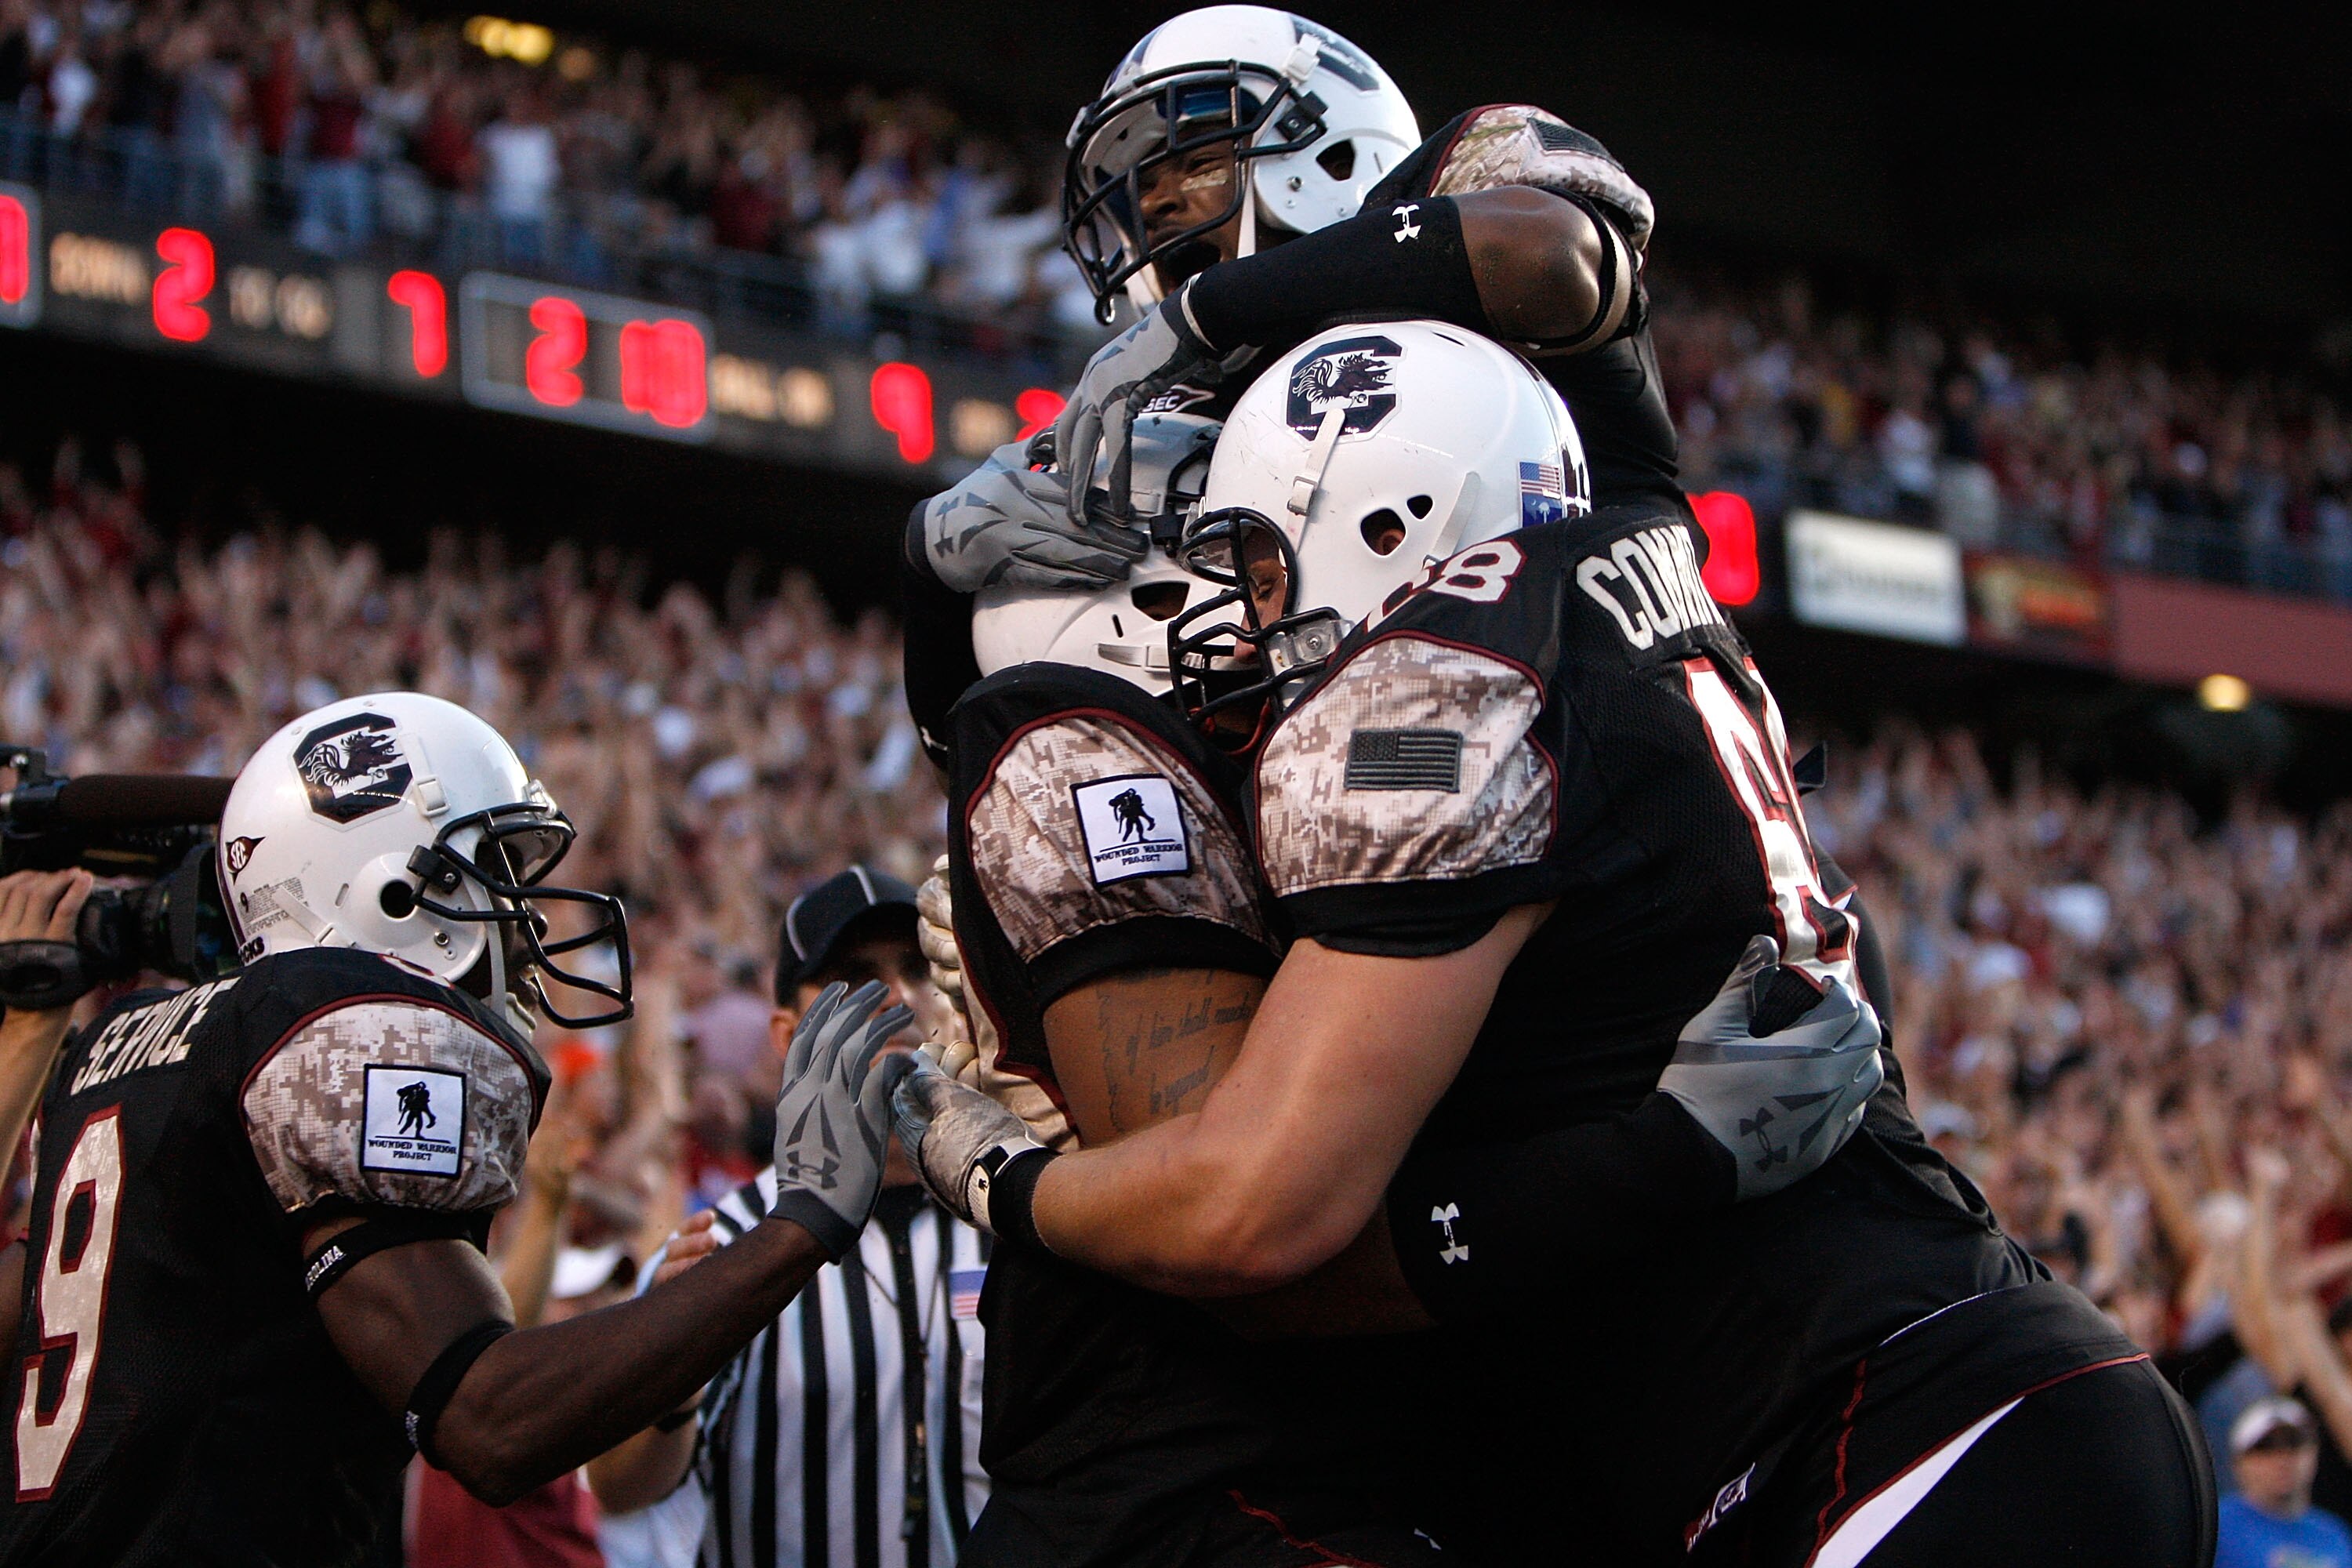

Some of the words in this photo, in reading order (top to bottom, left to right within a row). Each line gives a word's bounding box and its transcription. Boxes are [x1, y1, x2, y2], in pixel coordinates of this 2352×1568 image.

[153, 227, 215, 343] 2
[526, 297, 586, 407] 2
[1142, 395, 1180, 412] SEC
[1094, 847, 1139, 863] WOUNDED
[1143, 844, 1183, 854] WARRIOR
[1122, 854, 1161, 866] PROJECT
[71, 976, 241, 1096] SERVICE
[368, 1139, 412, 1150] WOUNDED
[417, 1142, 457, 1155] WARRIOR
[393, 1150, 433, 1161] PROJECT
[14, 1102, 123, 1503] 9
